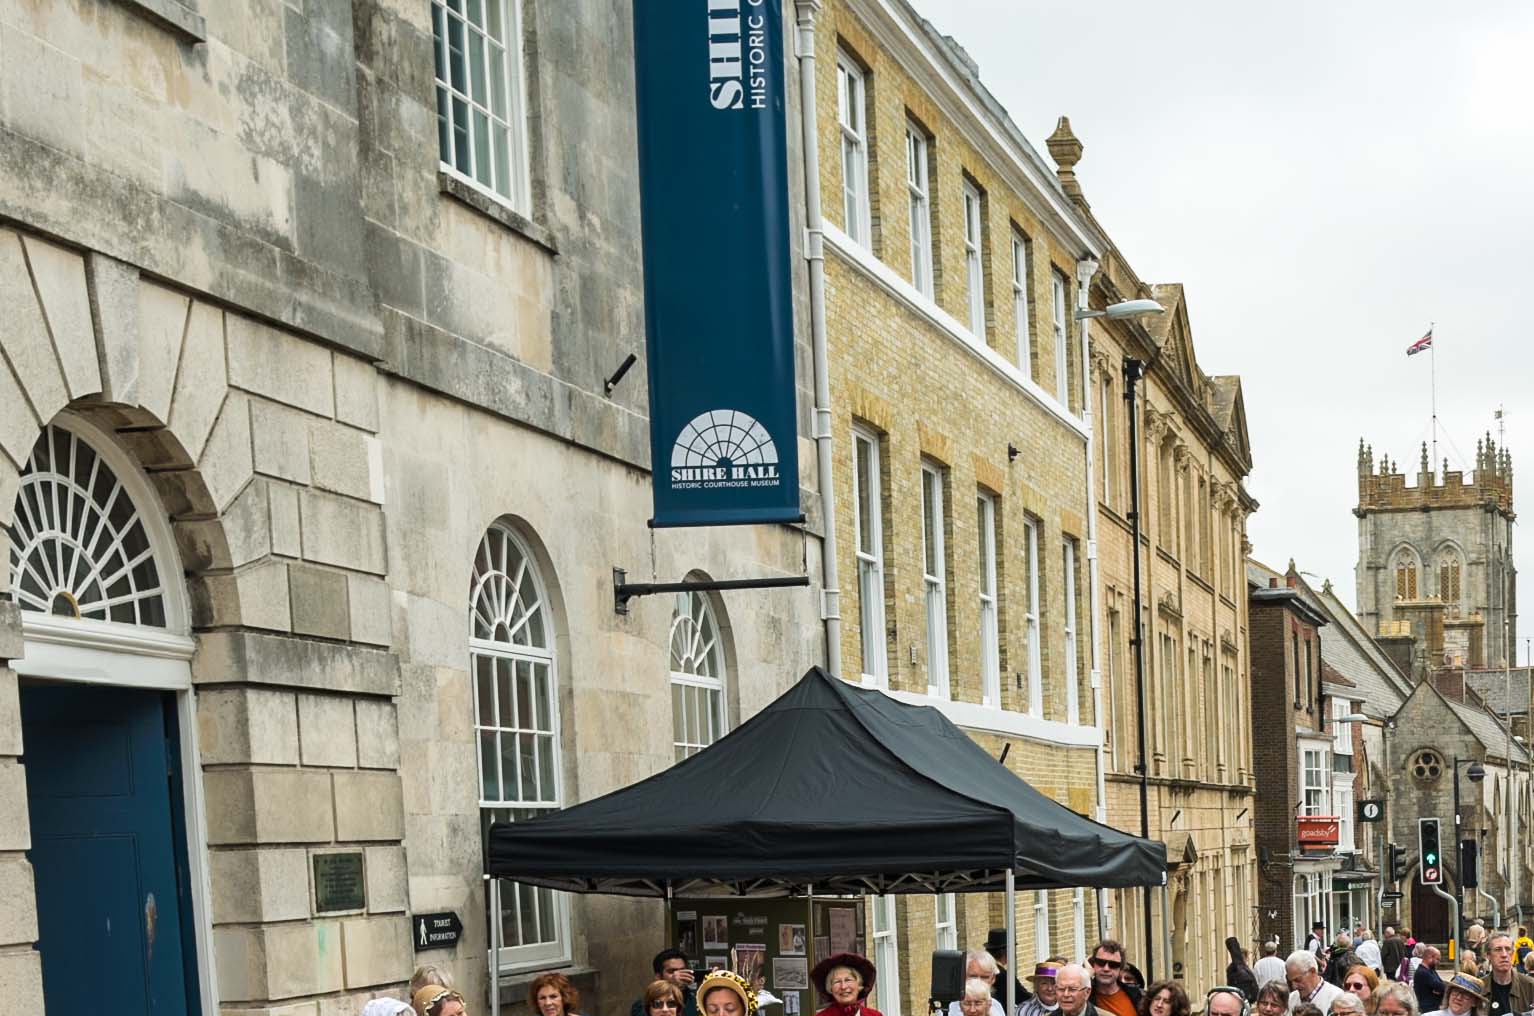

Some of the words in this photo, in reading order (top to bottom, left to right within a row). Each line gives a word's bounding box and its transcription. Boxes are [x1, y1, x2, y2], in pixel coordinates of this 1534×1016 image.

[708, 0, 744, 110] SHI
[748, 15, 766, 108] HISTORIC
[671, 467, 727, 482] SHIRE
[732, 465, 780, 479] HALL
[672, 482, 703, 490] HISTORIC
[704, 480, 749, 489] COURTHOUSE
[751, 479, 780, 487] MUSEUM
[1301, 828, 1330, 838] goadsby
[433, 918, 451, 928] TOURIST
[429, 932, 457, 942] INFORMATION
